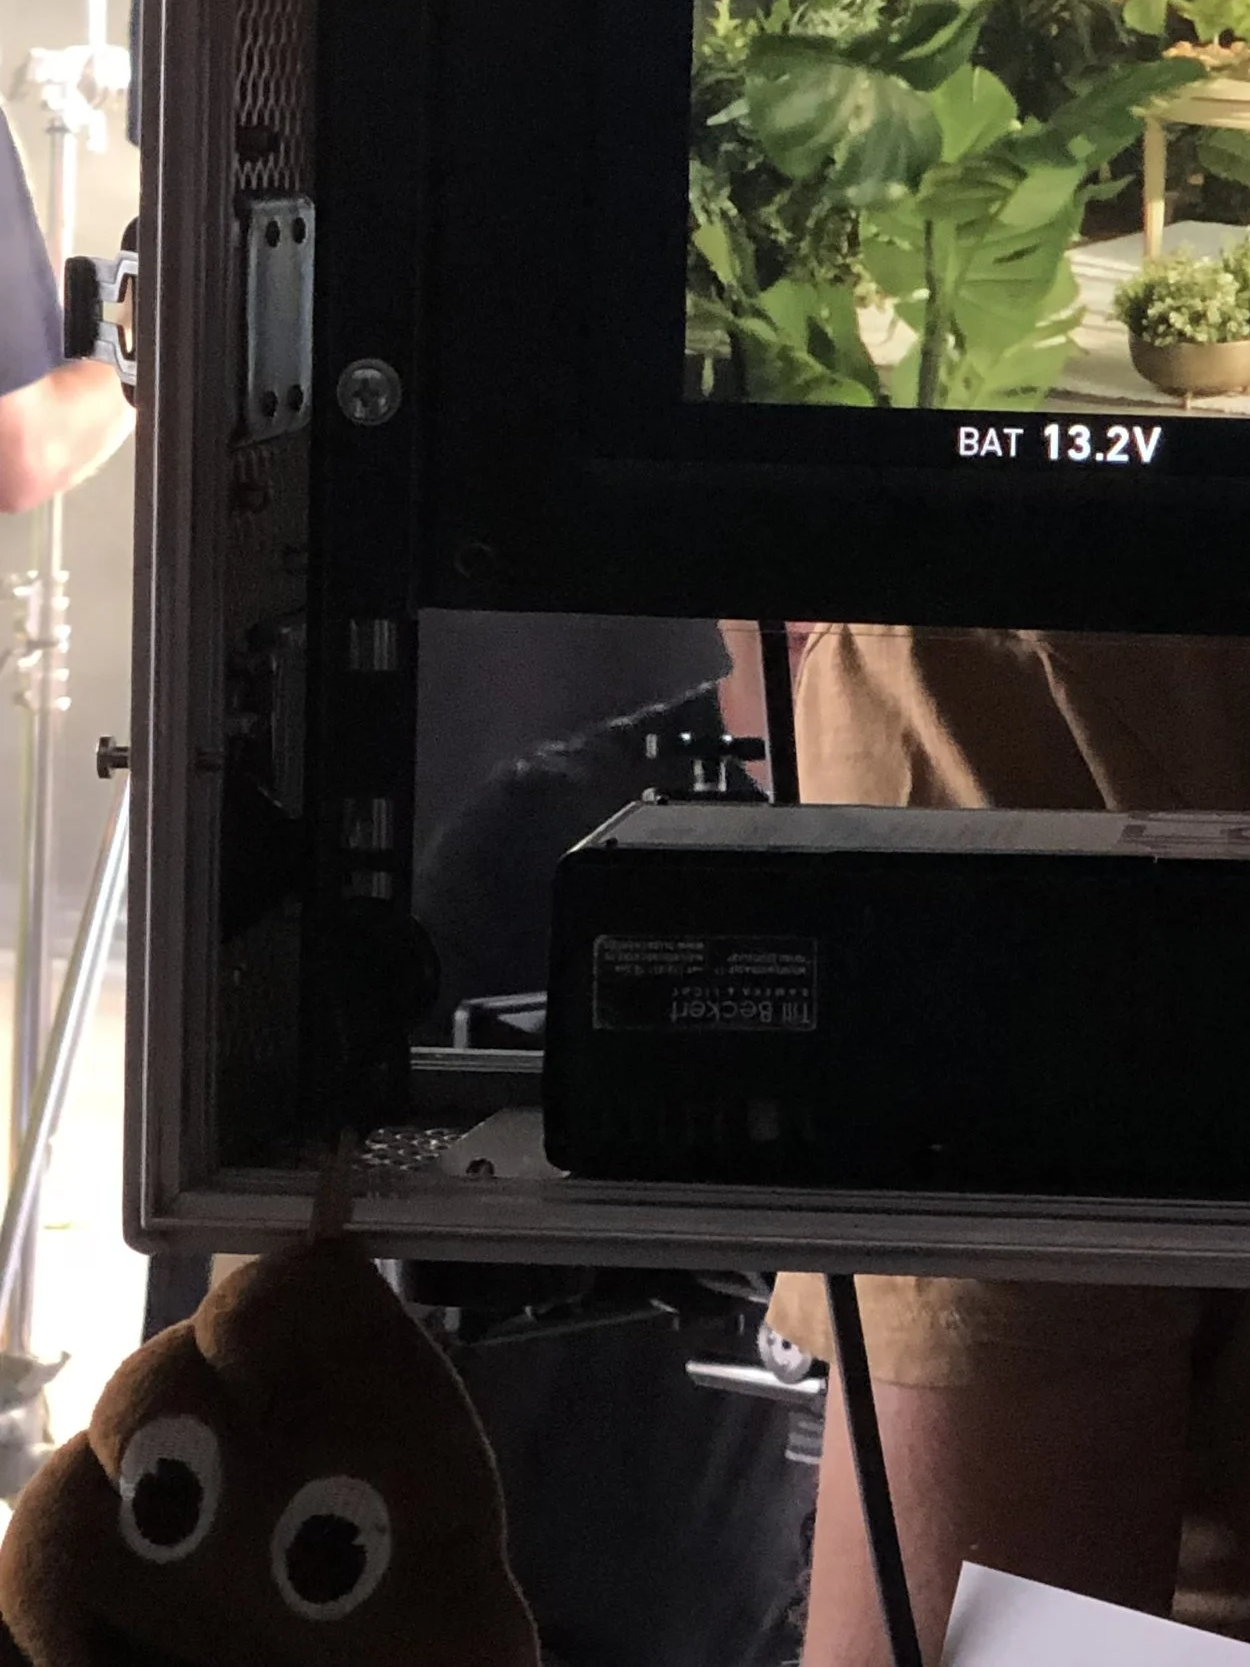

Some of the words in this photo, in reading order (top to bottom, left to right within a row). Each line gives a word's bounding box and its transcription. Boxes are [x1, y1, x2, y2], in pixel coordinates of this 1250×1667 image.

[959, 426, 1025, 458] BAT
[1043, 423, 1162, 464] 13.2V
[669, 1001, 773, 1024] Beckert
[781, 1002, 812, 1024] Till
